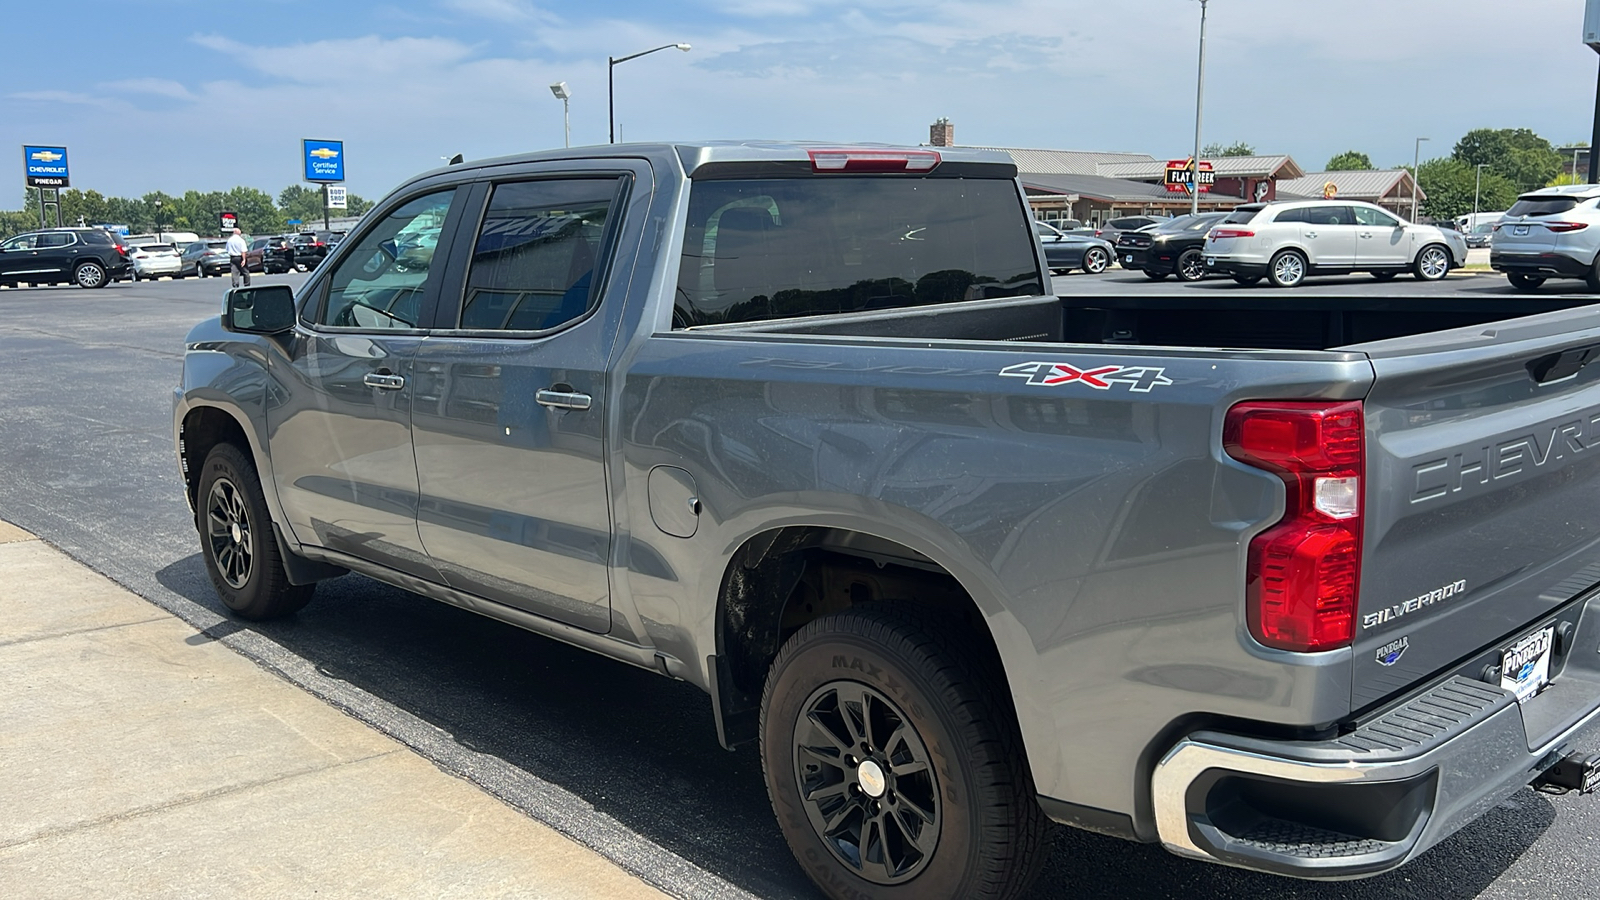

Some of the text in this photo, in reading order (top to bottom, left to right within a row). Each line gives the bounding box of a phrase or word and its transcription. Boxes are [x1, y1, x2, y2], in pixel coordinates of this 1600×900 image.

[312, 161, 338, 169] Certified
[1171, 171, 1190, 183] FLAT
[1362, 579, 1467, 629] SILVERADO
[1375, 636, 1409, 660] PINEGAR
[1502, 635, 1549, 676] PINEGAR
[831, 654, 925, 720] MAXXIS
